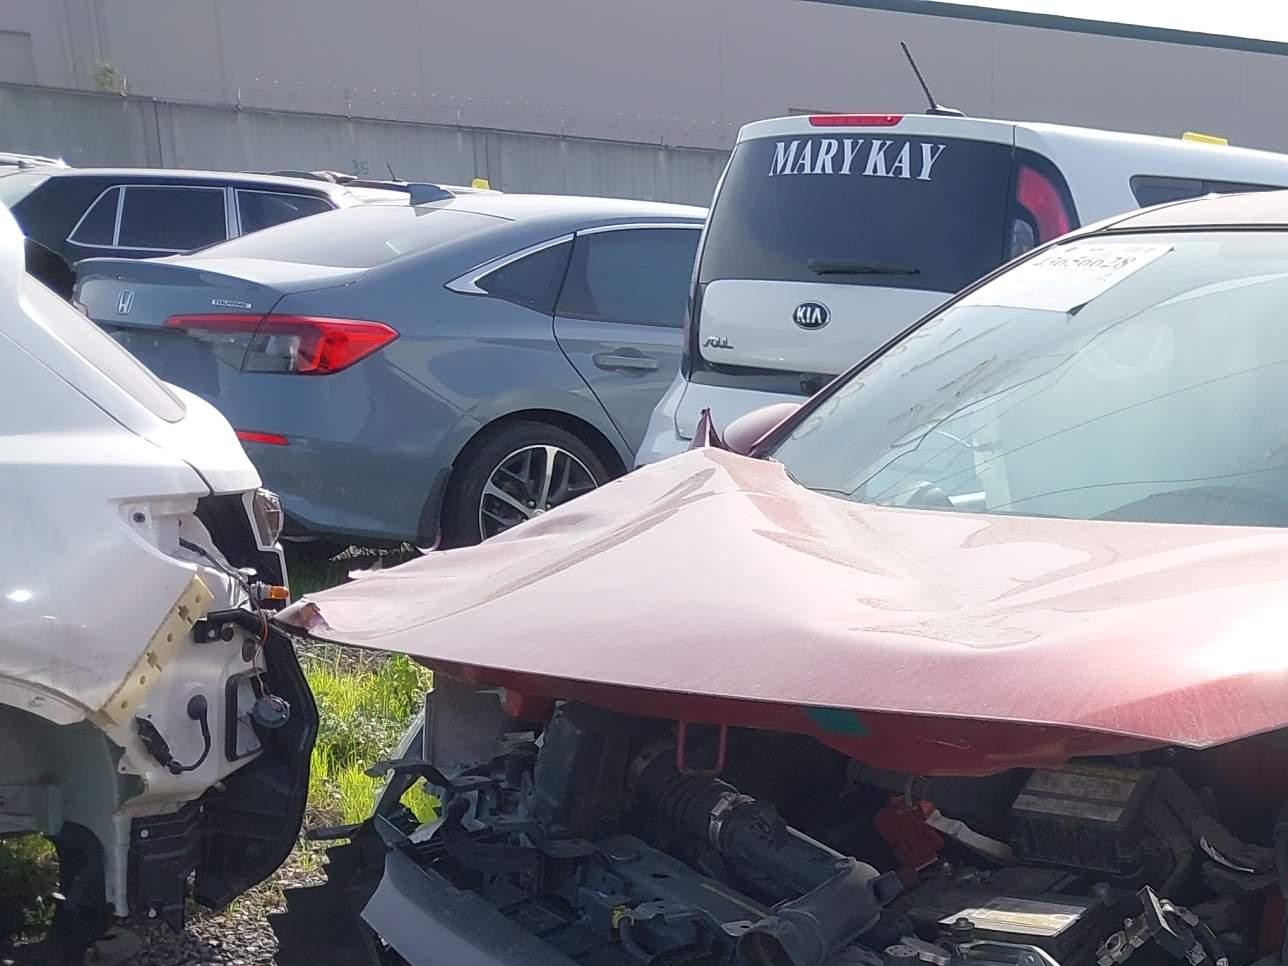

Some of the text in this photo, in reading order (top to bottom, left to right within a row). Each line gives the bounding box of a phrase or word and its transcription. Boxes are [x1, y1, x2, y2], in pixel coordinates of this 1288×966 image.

[768, 139, 946, 180] MARY KAY
[796, 305, 822, 324] KIA
